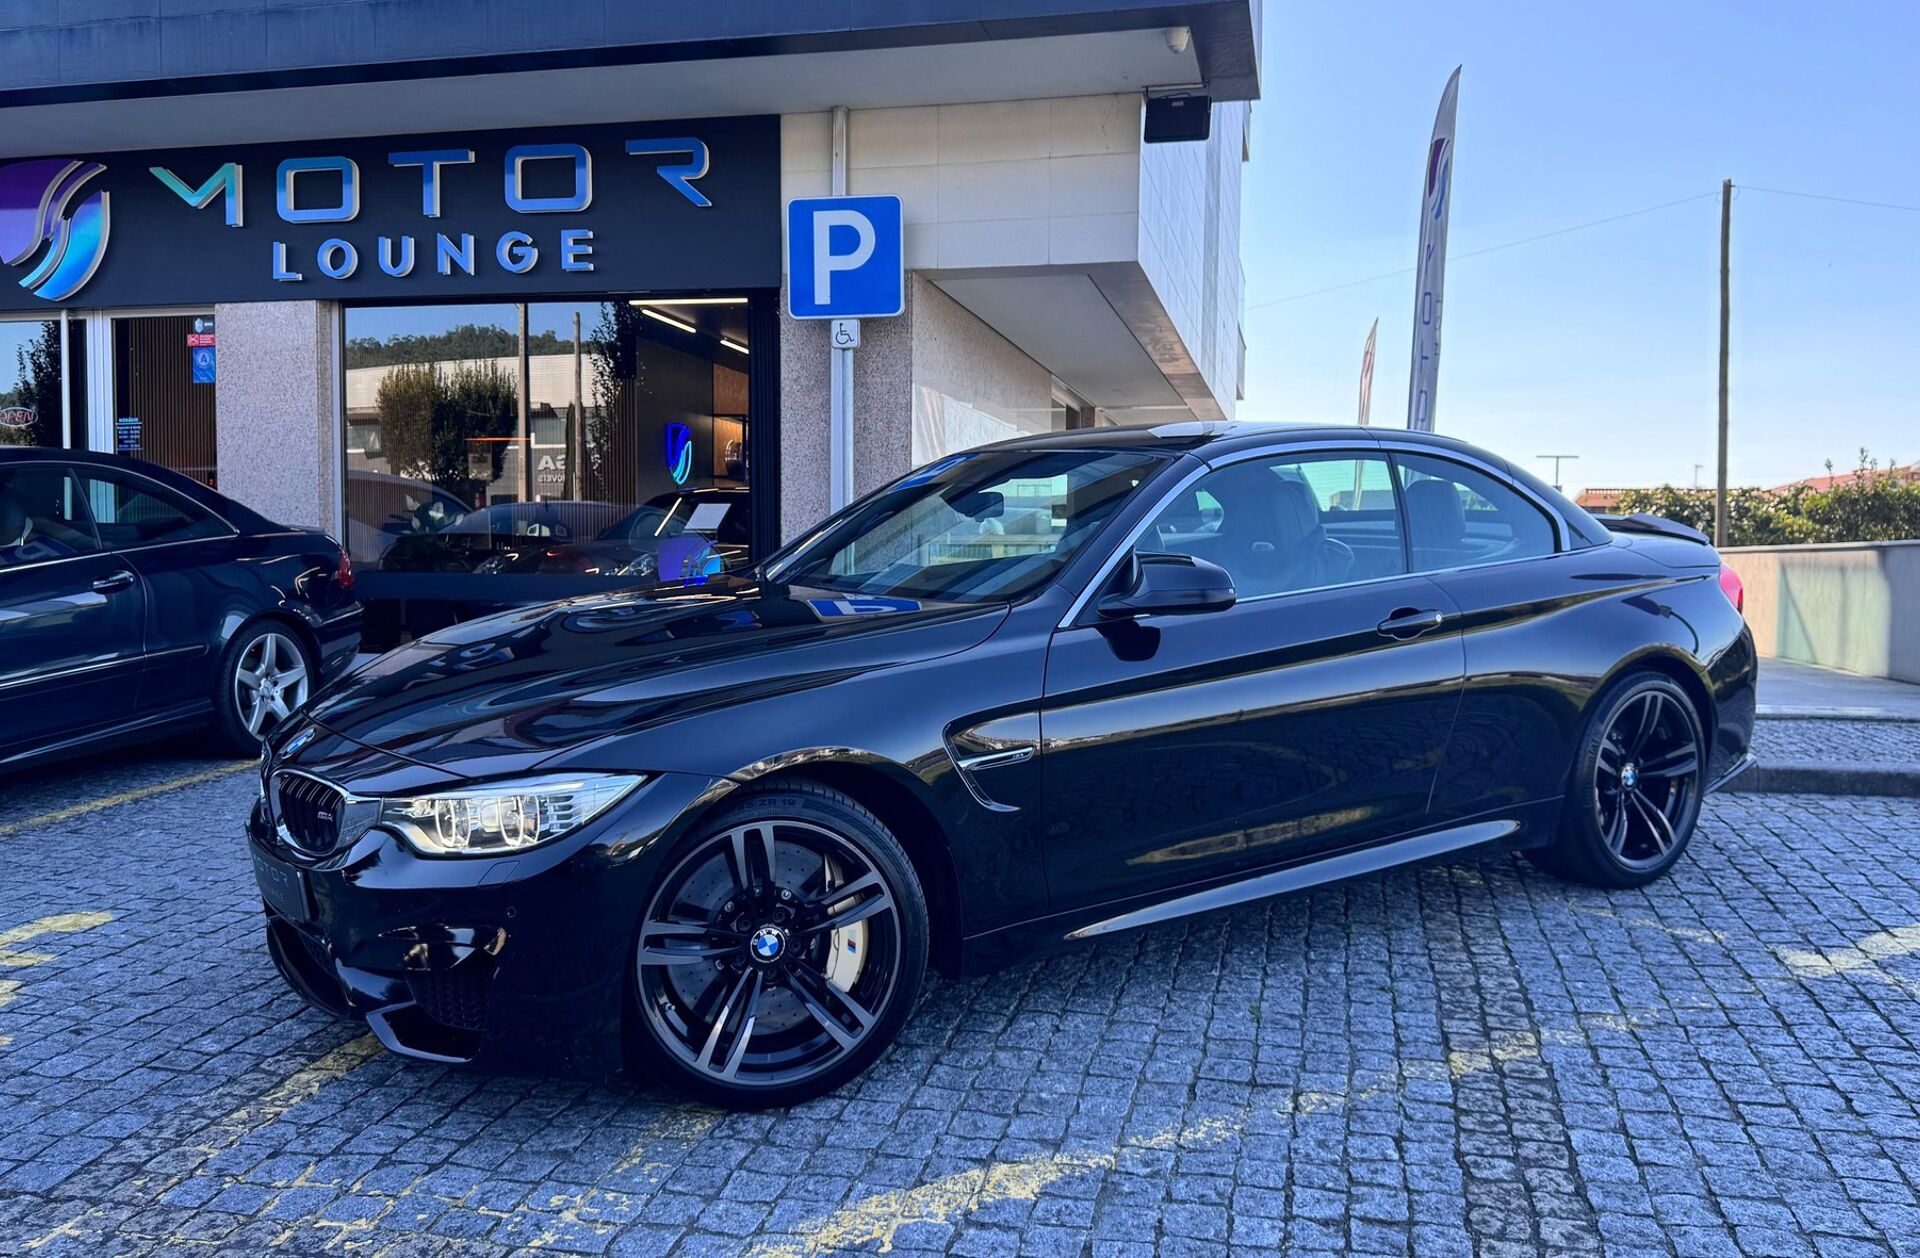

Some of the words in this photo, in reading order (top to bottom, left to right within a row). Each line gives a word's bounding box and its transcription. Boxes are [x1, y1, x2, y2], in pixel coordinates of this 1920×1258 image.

[149, 137, 712, 227] MOTOR
[271, 229, 596, 281] LOUNGE
[813, 210, 876, 305] P
